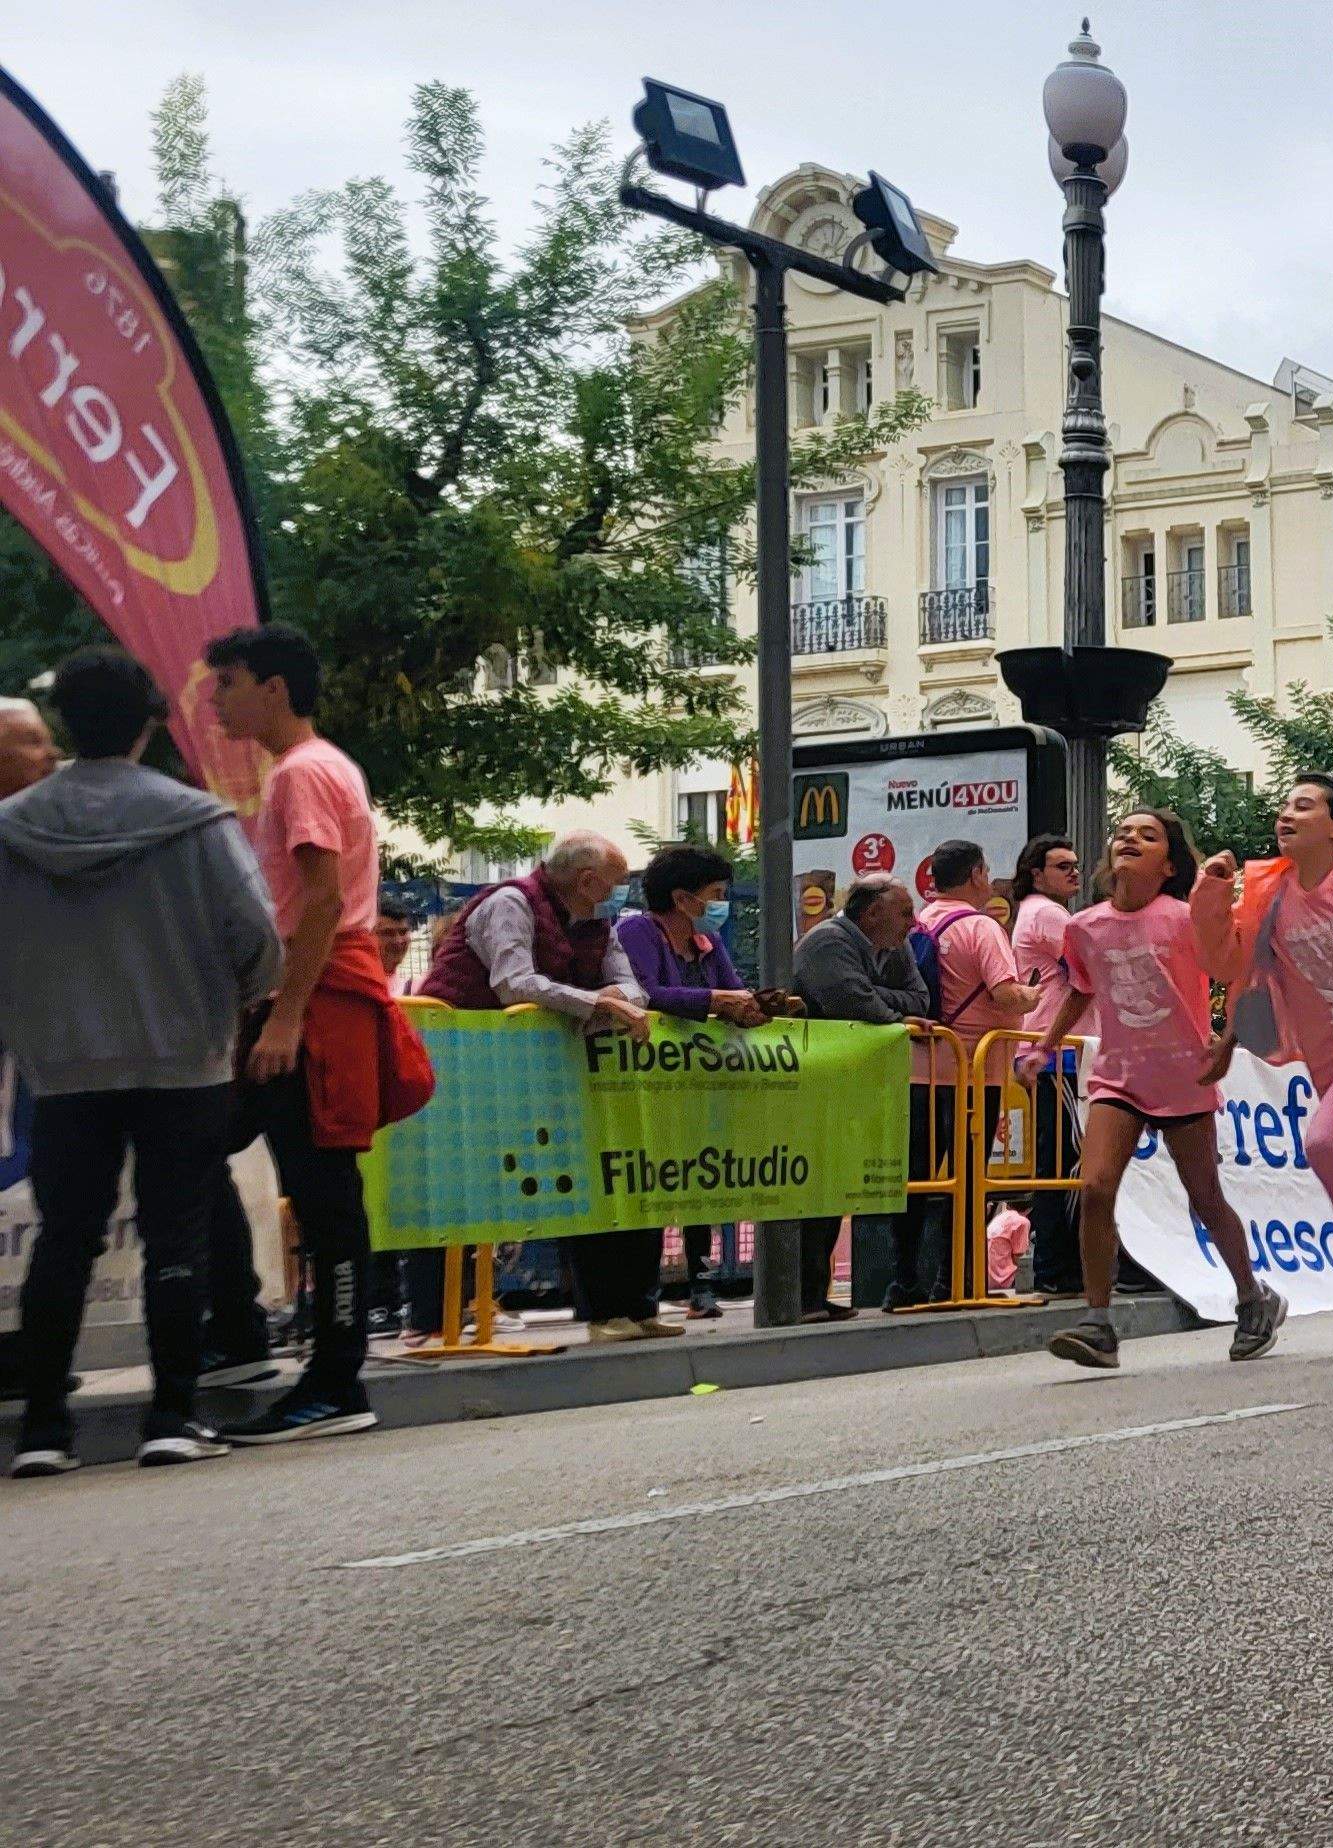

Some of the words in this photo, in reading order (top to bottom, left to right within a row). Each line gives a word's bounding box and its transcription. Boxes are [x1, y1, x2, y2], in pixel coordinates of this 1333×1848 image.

[887, 781, 950, 811] MENÚ
[954, 781, 1017, 806] 4YOU
[888, 780, 918, 789] Nuevo
[585, 1030, 800, 1073] FiberSalud
[600, 1145, 809, 1196] FiberStudio
[334, 1259, 356, 1327] Joma
